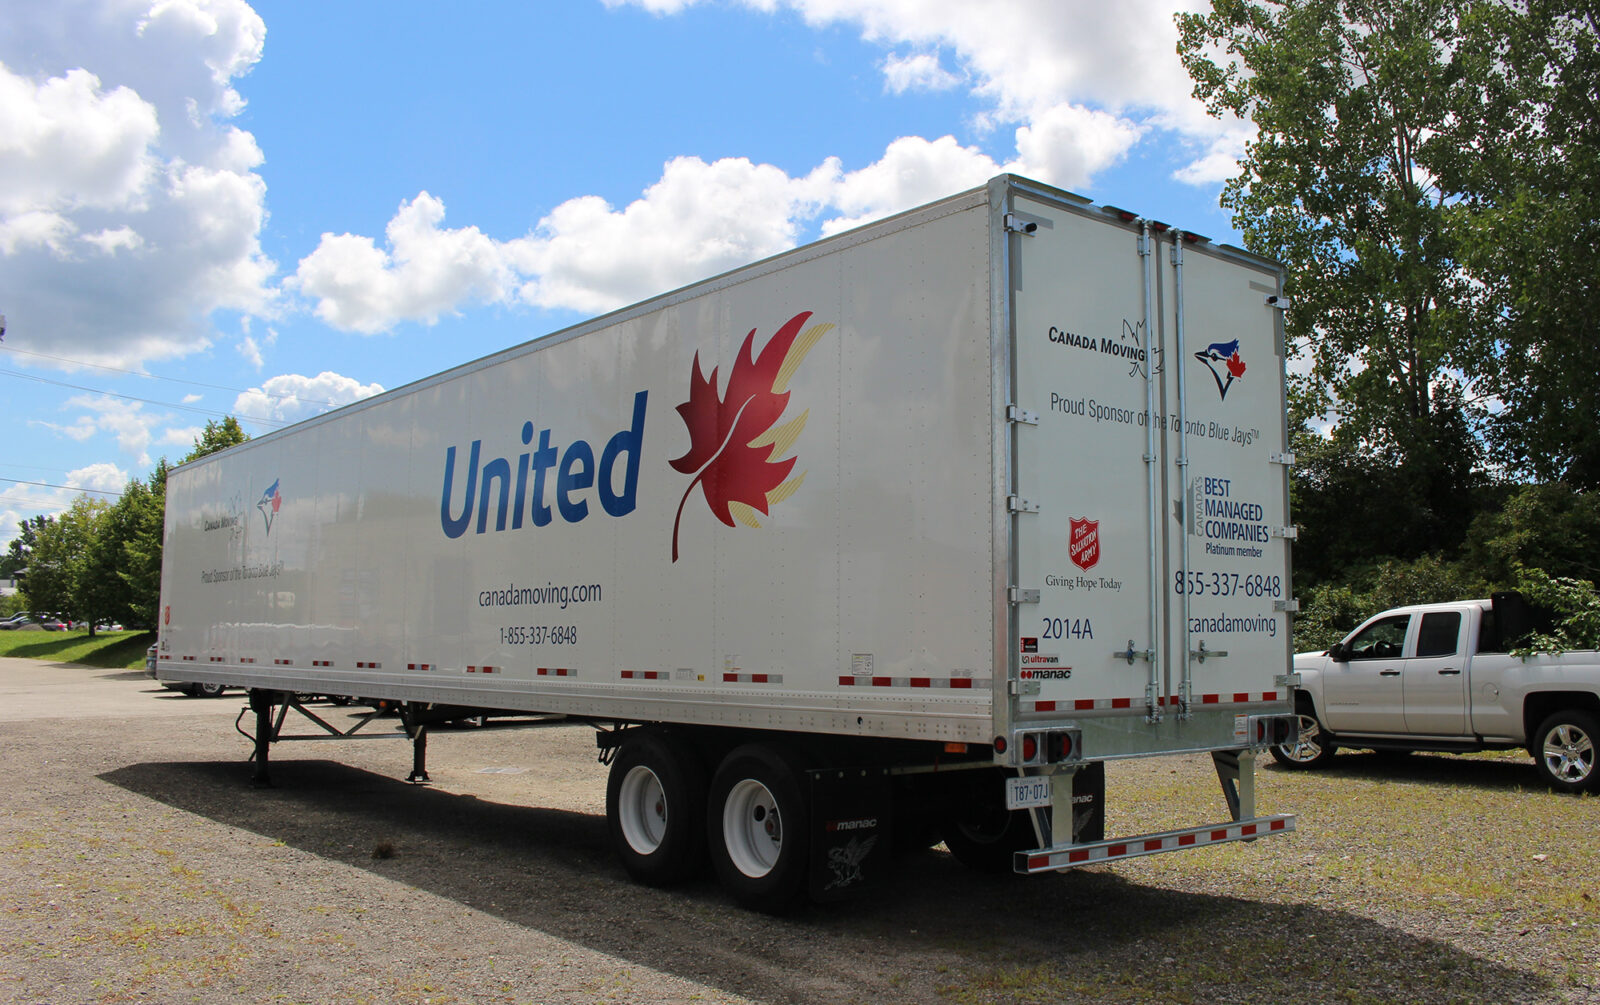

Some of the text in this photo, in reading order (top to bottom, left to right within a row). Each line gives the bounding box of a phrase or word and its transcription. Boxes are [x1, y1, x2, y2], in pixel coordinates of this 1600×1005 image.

[1050, 392, 1085, 416] Proud
[1088, 399, 1134, 425] Sponsor
[1150, 411, 1167, 430] he
[1170, 414, 1206, 437] Toonto
[1208, 421, 1229, 441] Blue
[440, 390, 648, 539] United
[1204, 477, 1231, 497] BEST
[1205, 499, 1263, 522] MANAGED
[1075, 523, 1088, 539] THE
[1205, 520, 1269, 543] COMPANIES
[1080, 542, 1097, 565] ARMY
[1205, 542, 1263, 558] Platinum member
[1045, 574, 1122, 593] Giving Hope Today
[479, 581, 602, 610] canadamoving.com
[500, 625, 577, 645] 1-855-337-6848
[1042, 617, 1093, 640] 2014A
[1188, 612, 1276, 637] canadamoving
[1030, 655, 1059, 664] ultravan
[1032, 670, 1071, 679] manac
[836, 818, 878, 831] manac
